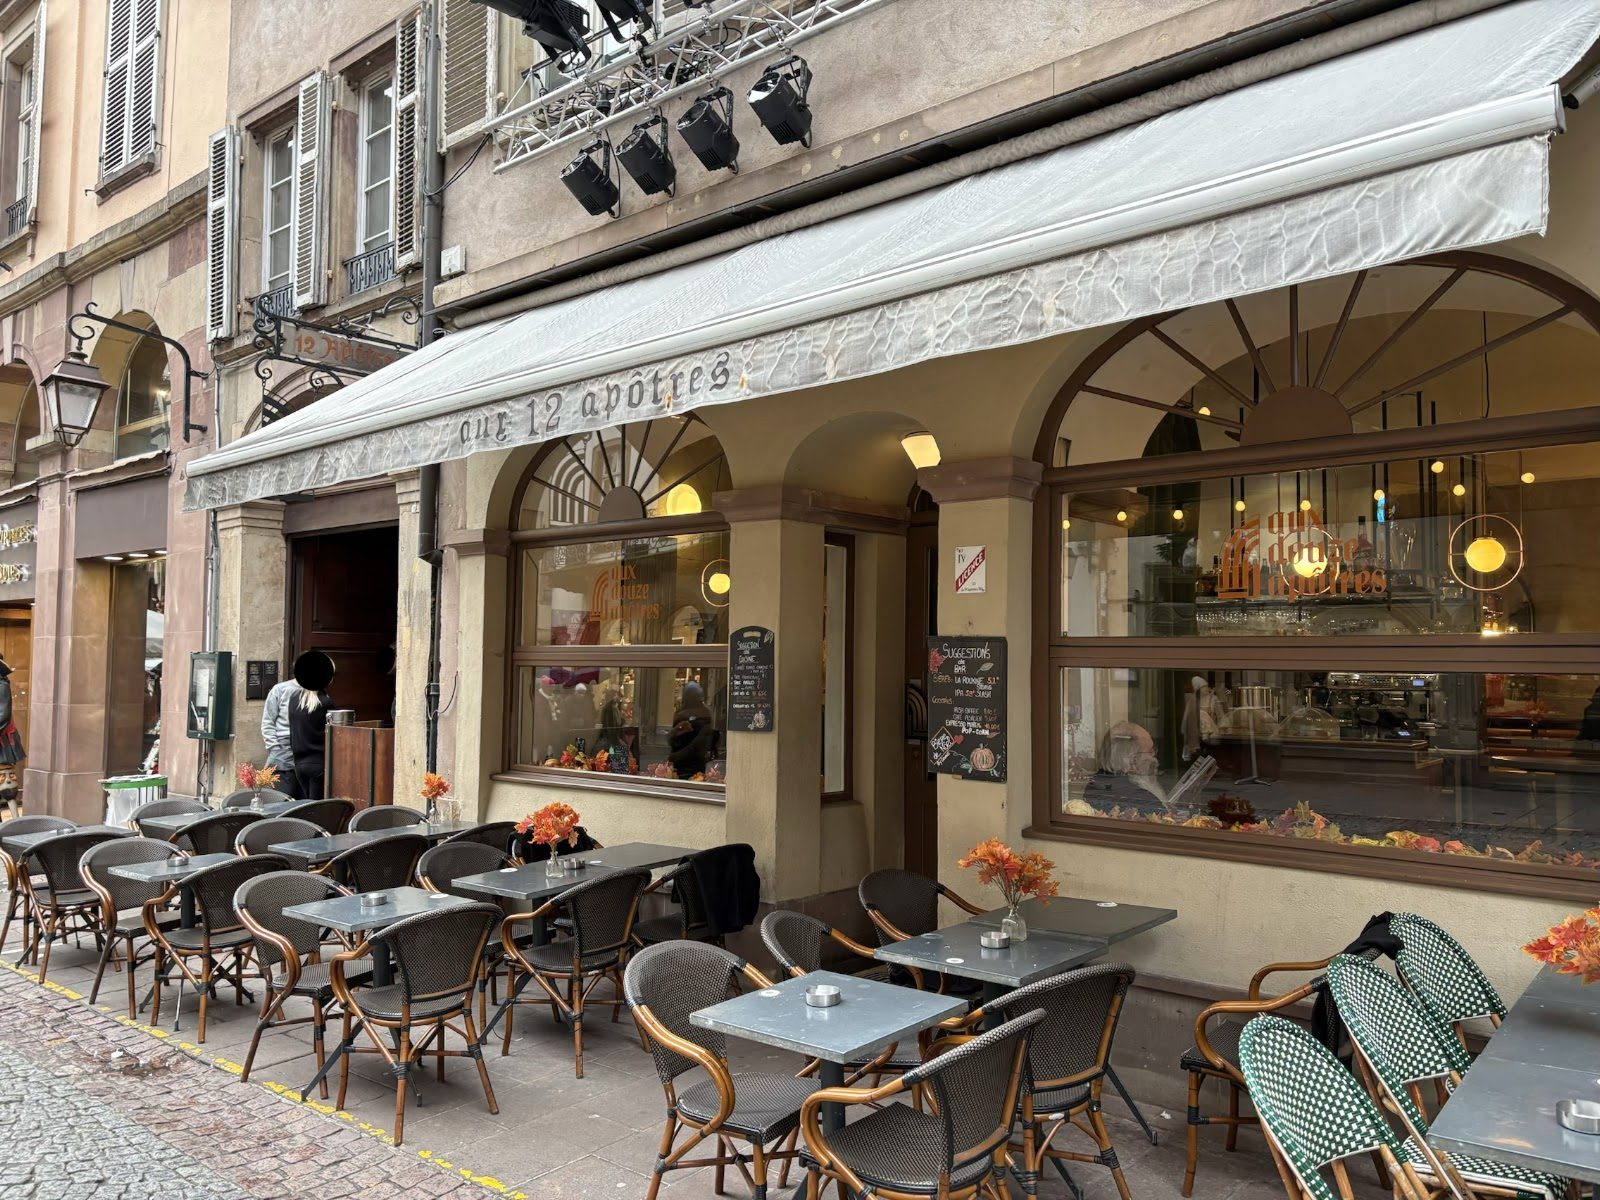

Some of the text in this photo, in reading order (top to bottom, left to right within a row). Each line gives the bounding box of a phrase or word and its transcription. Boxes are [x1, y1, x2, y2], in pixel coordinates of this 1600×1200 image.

[296, 334, 315, 355] 12
[460, 351, 730, 444] aux 12 apôtres
[1268, 511, 1325, 535] aux
[1268, 531, 1360, 564] douze
[958, 552, 984, 587] LICENCE
[1268, 567, 1387, 604] apôtres
[943, 642, 991, 659] SUGGESTIONS
[954, 665, 966, 673] BAR
